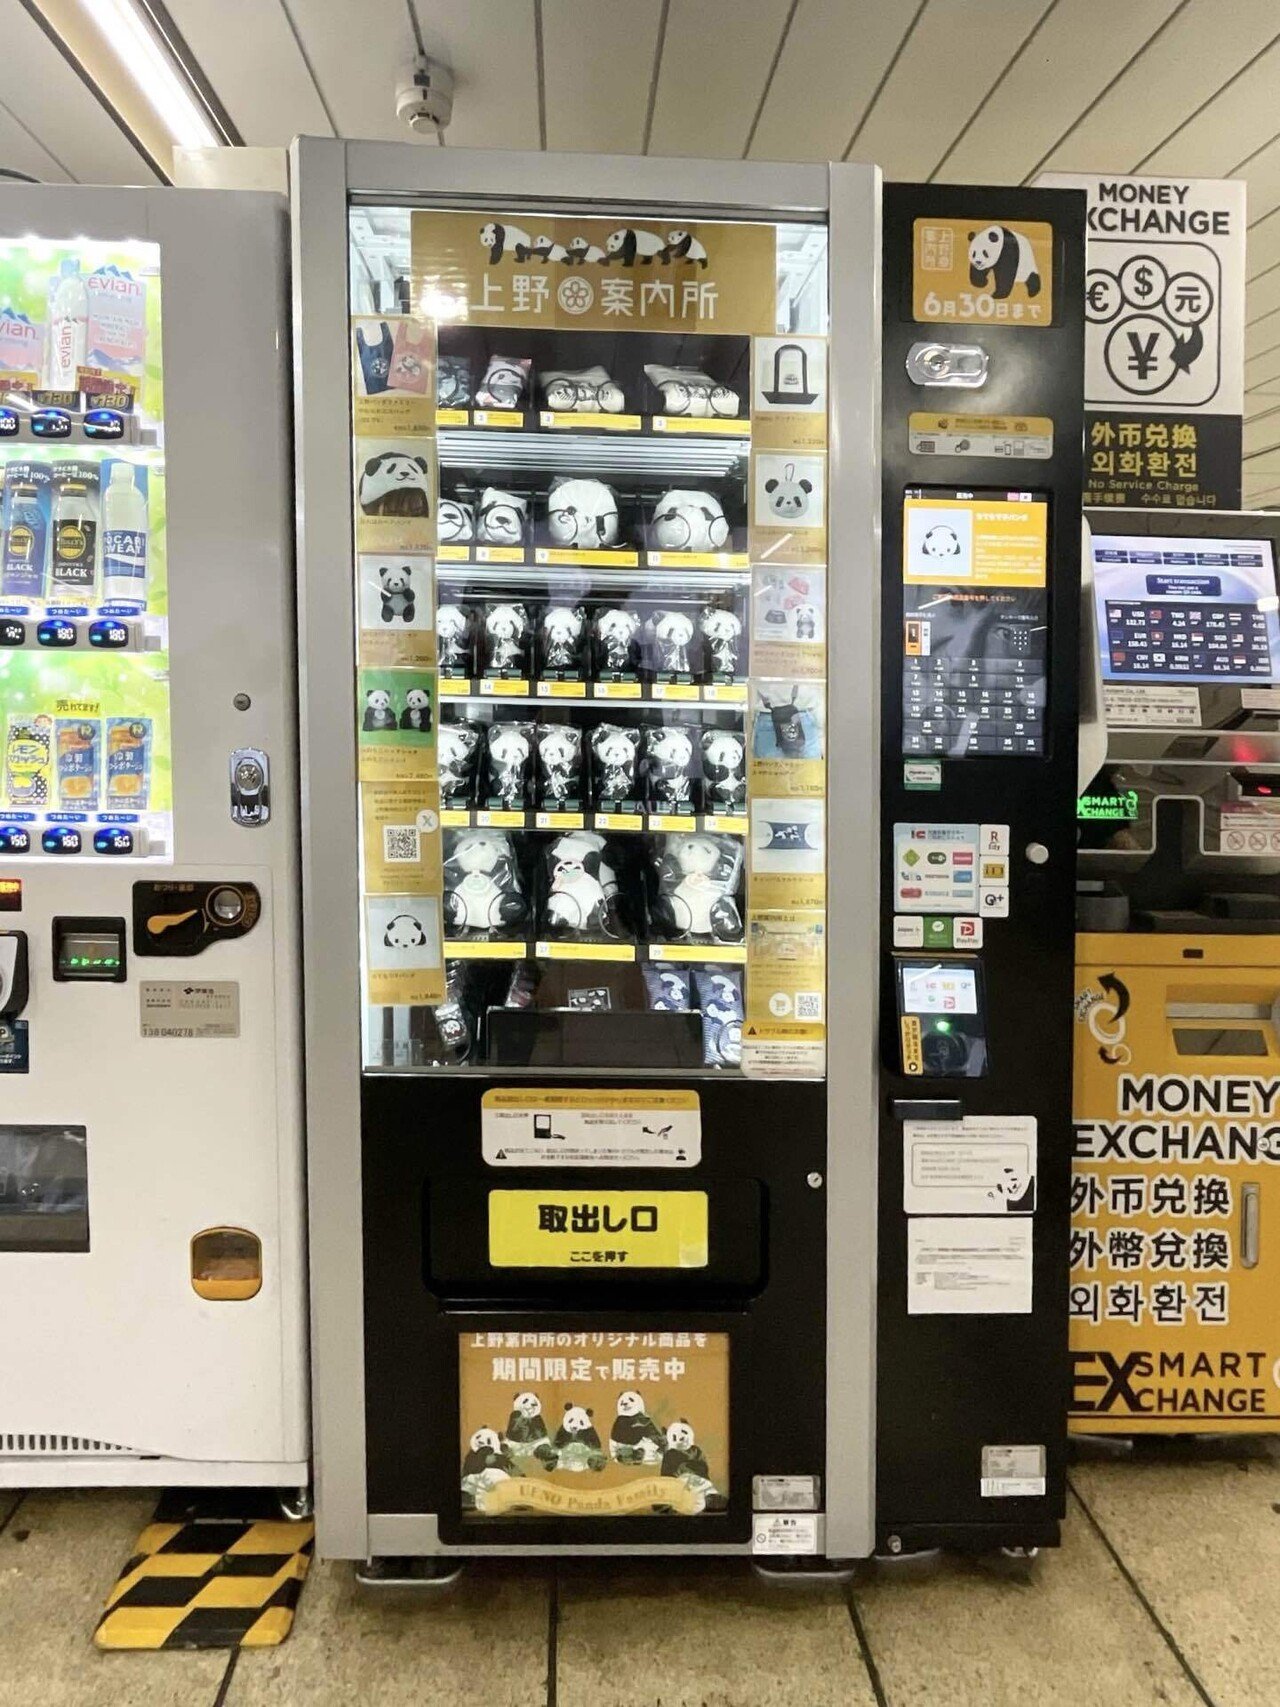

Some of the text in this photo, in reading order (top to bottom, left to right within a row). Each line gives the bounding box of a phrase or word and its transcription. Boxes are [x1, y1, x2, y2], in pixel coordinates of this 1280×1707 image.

[1099, 183, 1190, 205] MONEY
[88, 276, 141, 296] evian
[468, 272, 719, 319] 上野 案内所
[924, 291, 1041, 319] 6月30日まで
[1175, 286, 1202, 313] 元
[61, 325, 72, 368] evian
[1091, 450, 1198, 478] 외화환전
[1088, 479, 1199, 492] No Service Charge
[1085, 796, 1125, 807] SMART
[1086, 807, 1125, 817] CHANGE
[1122, 1078, 1280, 1113] MONEY
[538, 1203, 658, 1233] 取出し口
[570, 1250, 629, 1263] ここを押す
[1070, 1284, 1226, 1322] 외화환전
[470, 1332, 708, 1348] 上野案内所のオリジナル商品を
[492, 1356, 686, 1382] 期間限定で販売中
[1135, 1352, 1266, 1377] SMART
[1136, 1388, 1266, 1412] CHANGE
